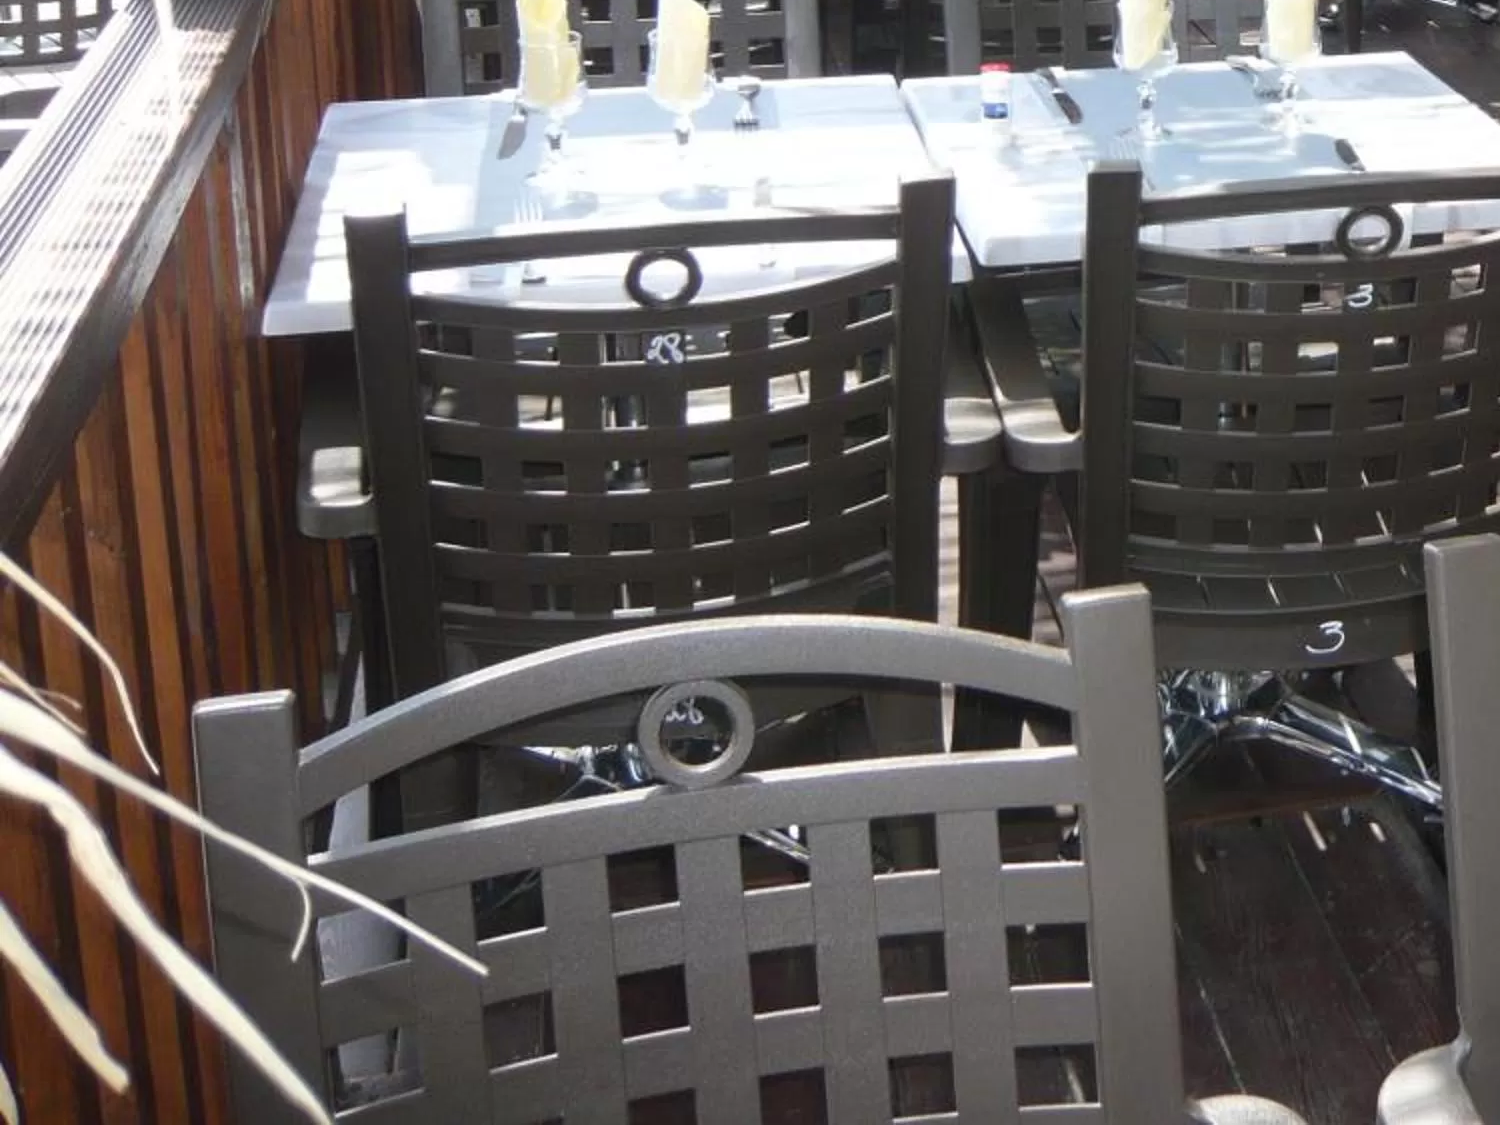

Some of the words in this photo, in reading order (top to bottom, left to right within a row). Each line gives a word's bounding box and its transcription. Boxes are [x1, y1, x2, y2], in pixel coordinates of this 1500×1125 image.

[1344, 282, 1374, 308] 3
[646, 331, 685, 365] 28
[1304, 619, 1346, 654] 3
